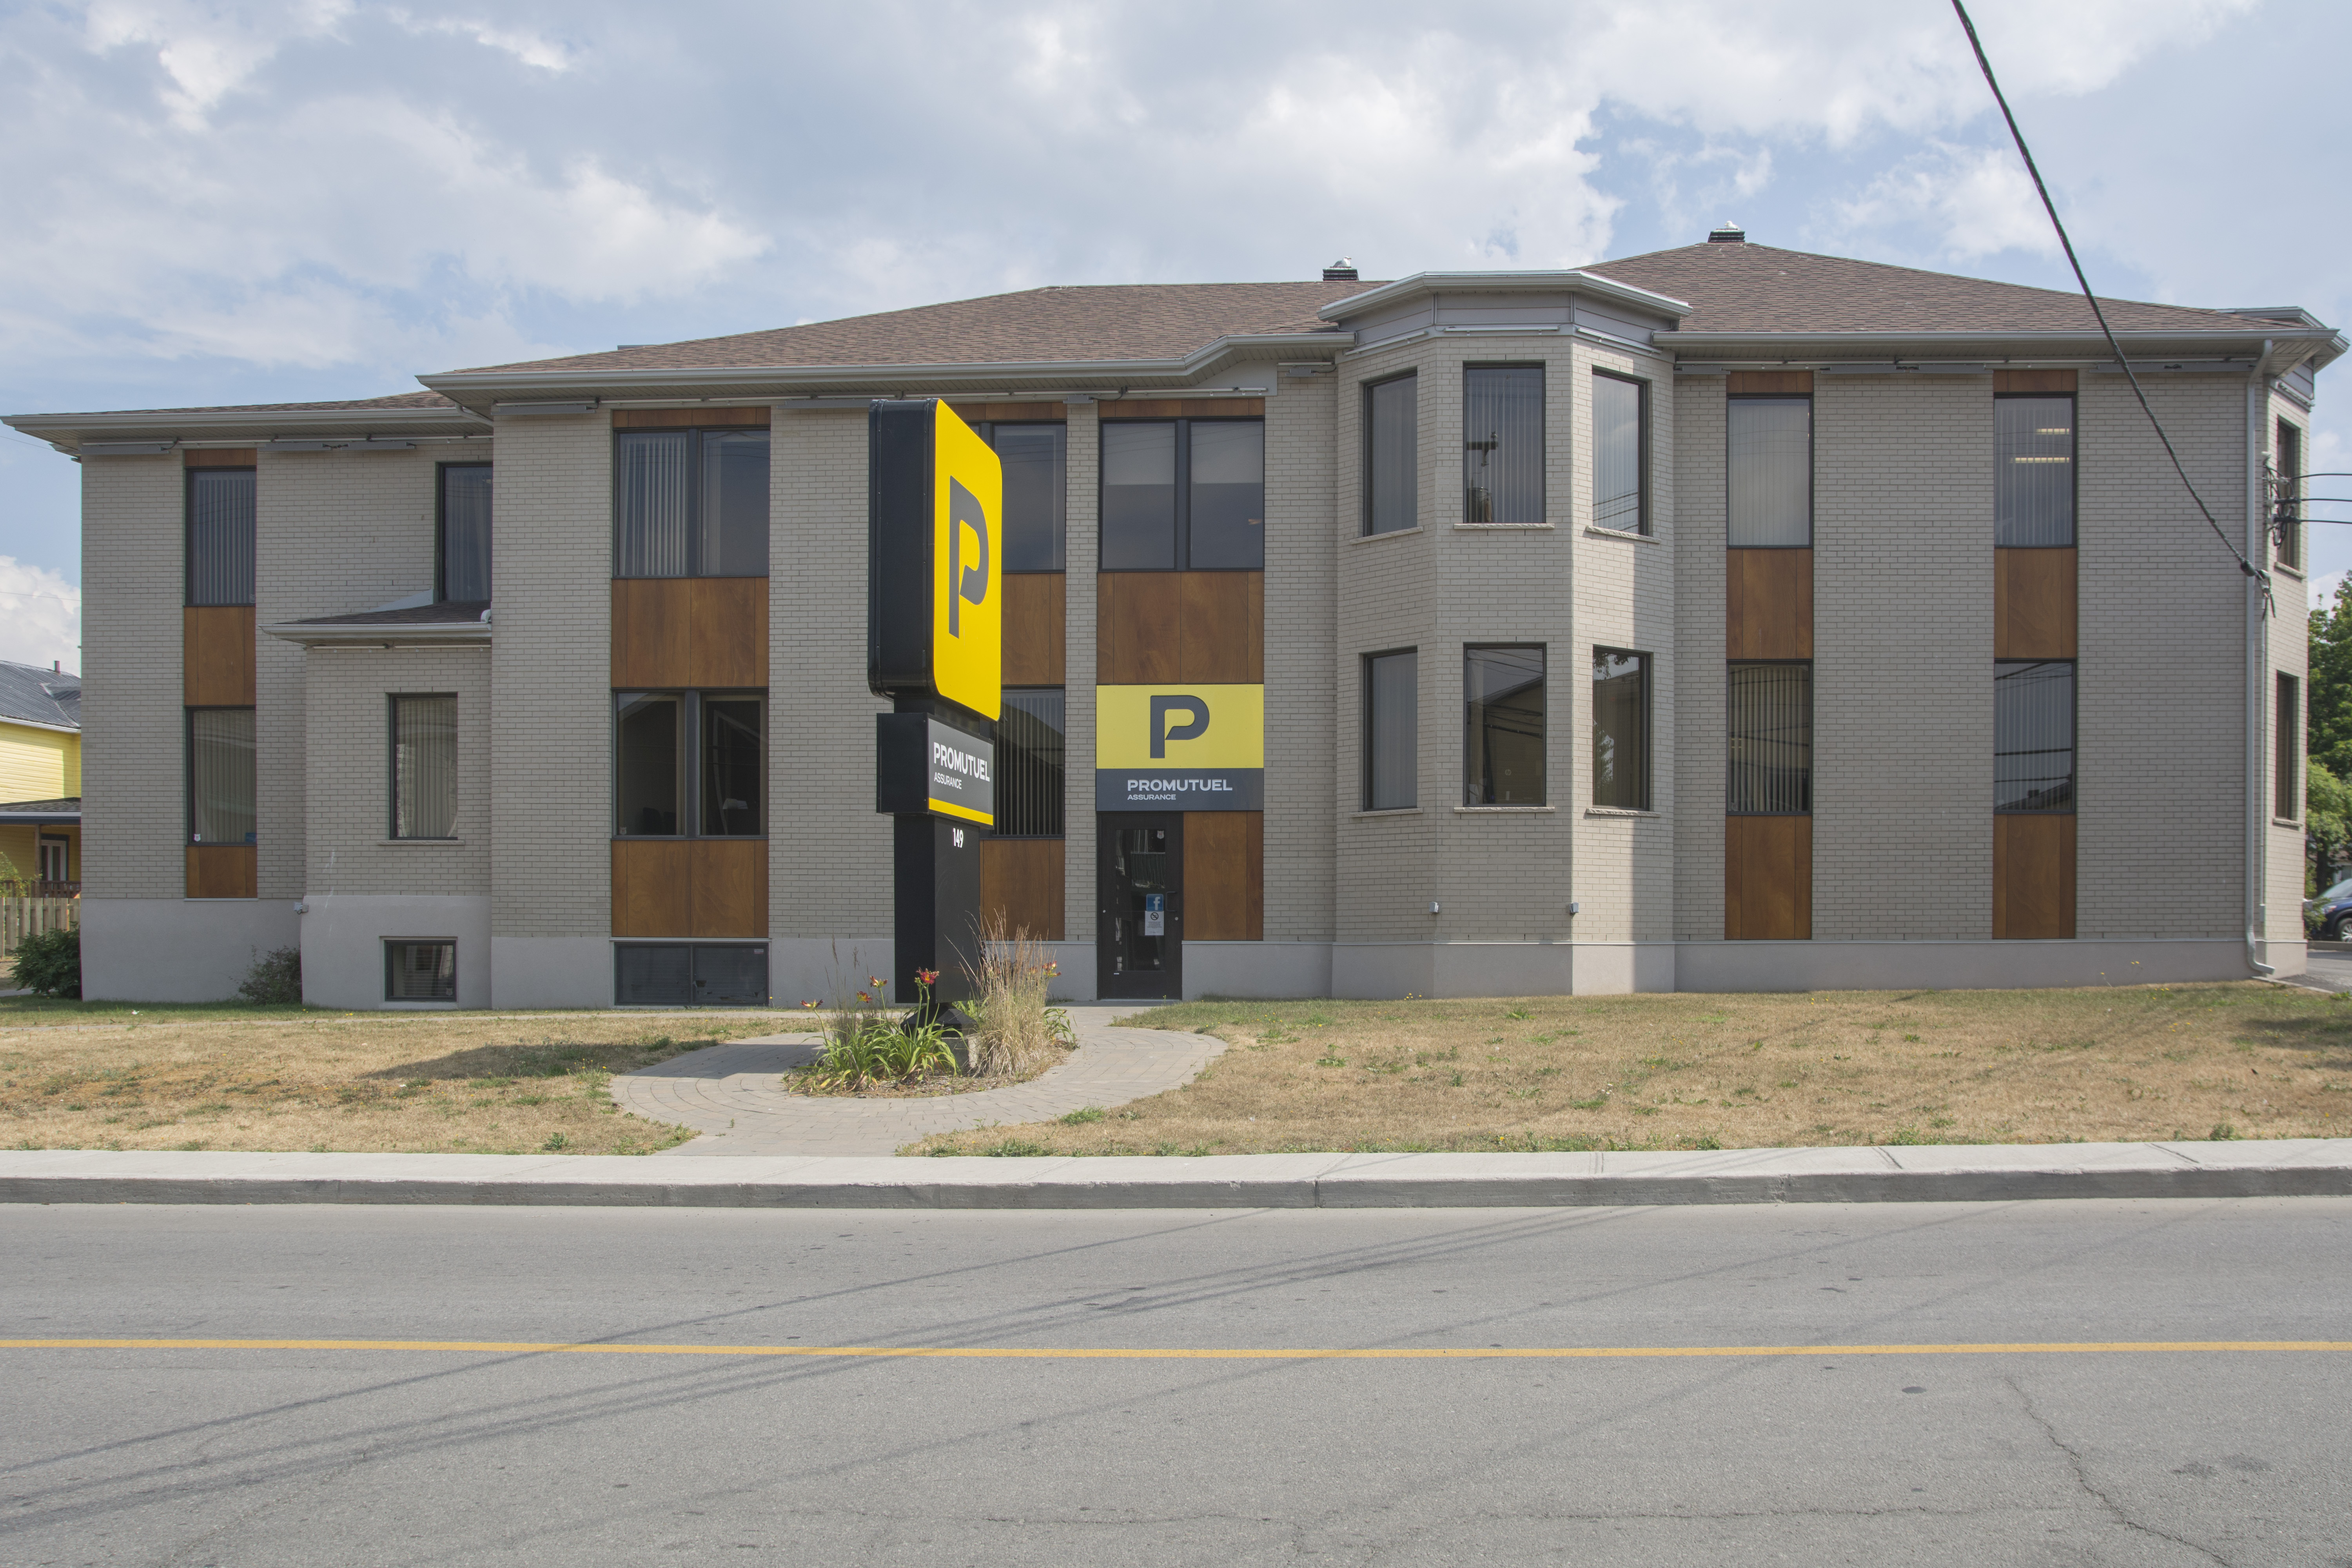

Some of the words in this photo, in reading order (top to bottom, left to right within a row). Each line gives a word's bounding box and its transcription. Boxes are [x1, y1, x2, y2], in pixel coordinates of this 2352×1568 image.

[949, 475, 989, 639] P
[1150, 695, 1210, 759] P
[933, 742, 990, 782] PROMUTUEL
[934, 772, 962, 789] ASSURANCE
[1127, 779, 1233, 791] PROMUTUEL
[953, 828, 964, 848] 149
